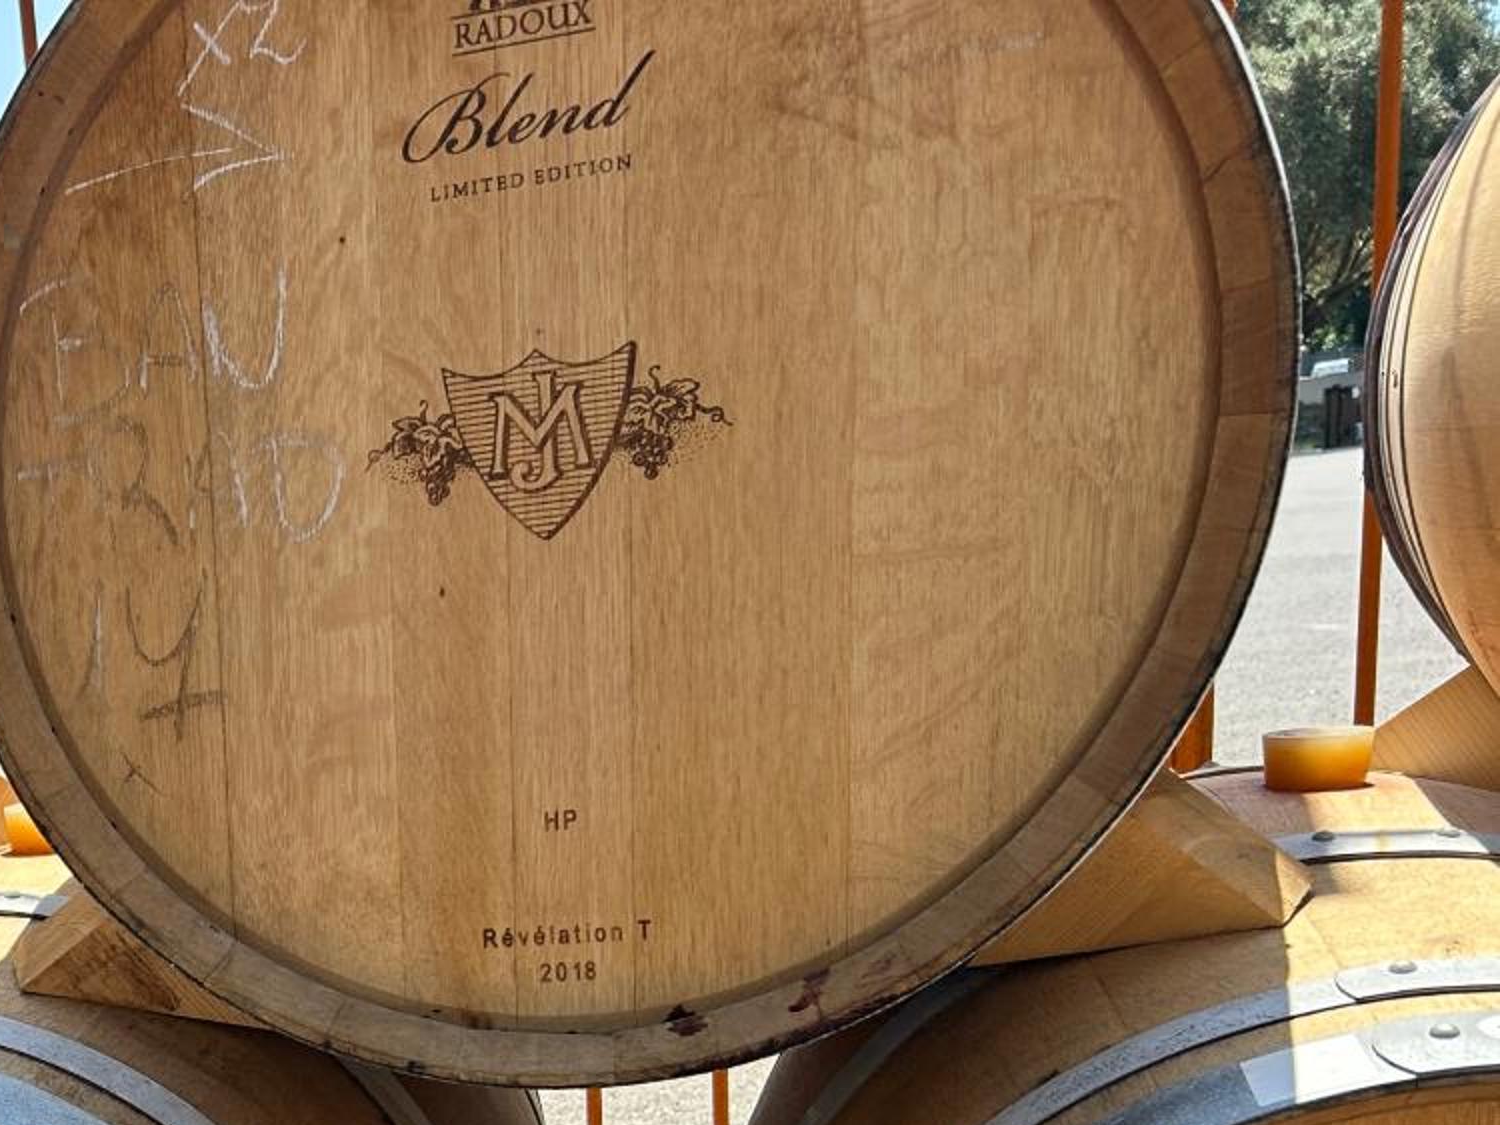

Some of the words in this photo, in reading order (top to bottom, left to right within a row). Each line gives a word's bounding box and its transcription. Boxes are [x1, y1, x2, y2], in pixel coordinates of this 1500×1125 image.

[453, 1, 592, 49] RADOUX
[401, 49, 656, 164] Blend
[430, 172, 525, 203] LIMITED
[534, 153, 632, 186] EDITION
[543, 808, 578, 832] HP
[482, 922, 624, 949] Révélation
[637, 919, 652, 941] T
[539, 961, 598, 983] 2018
